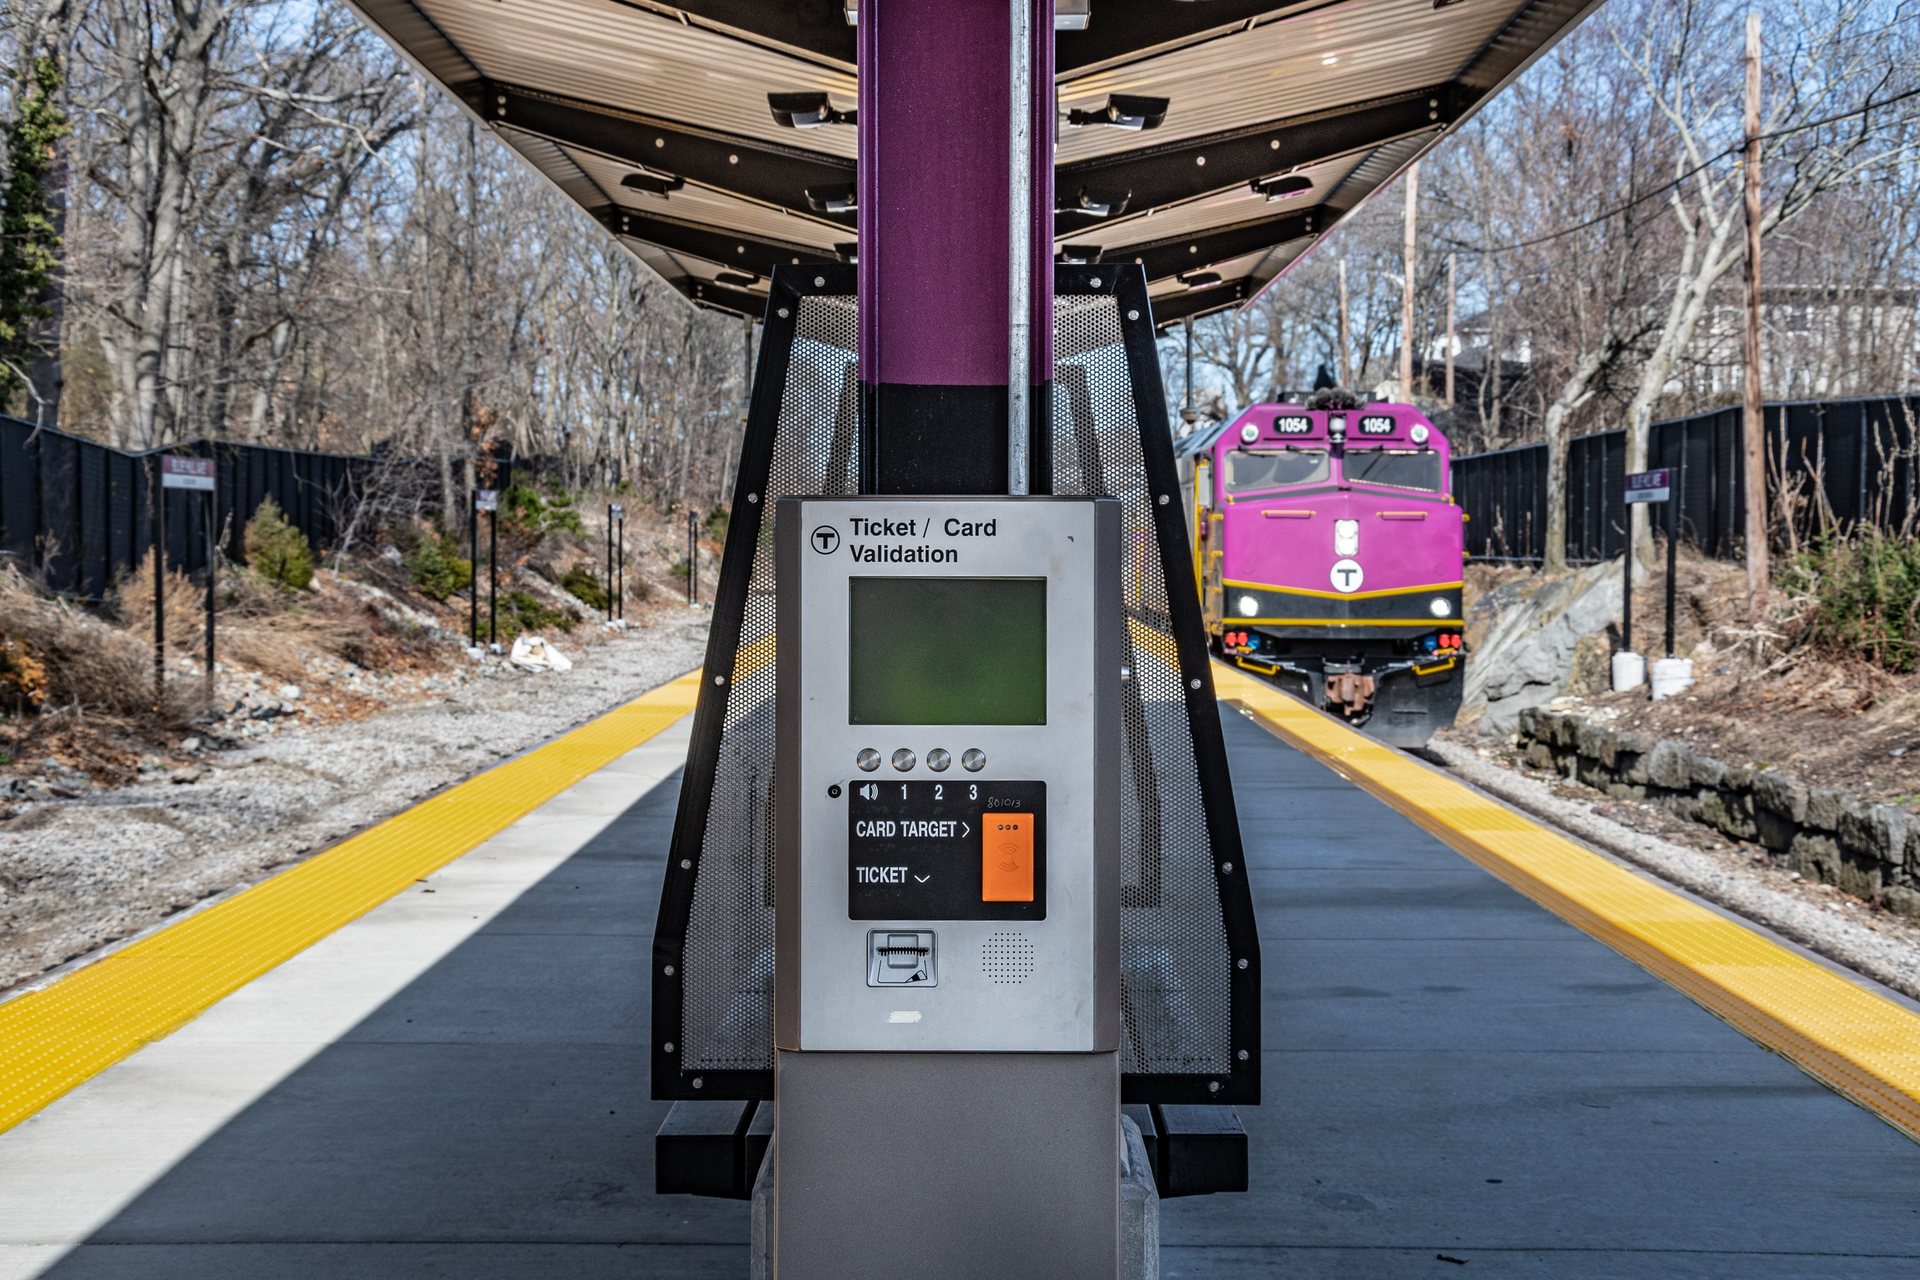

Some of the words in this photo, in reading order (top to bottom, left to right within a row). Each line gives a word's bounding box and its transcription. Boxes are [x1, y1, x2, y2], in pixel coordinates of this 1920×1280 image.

[1278, 417, 1308, 433] 1054
[1363, 417, 1391, 433] 1054
[849, 517, 917, 537] Ticket
[944, 517, 997, 537] Card
[816, 532, 836, 550] T
[849, 544, 958, 563] Validation
[900, 784, 908, 800] 1
[934, 784, 943, 800] 2
[969, 784, 978, 801] 3
[856, 820, 896, 838] CARD
[900, 820, 957, 838] TARGET
[855, 866, 908, 884] TICKET
